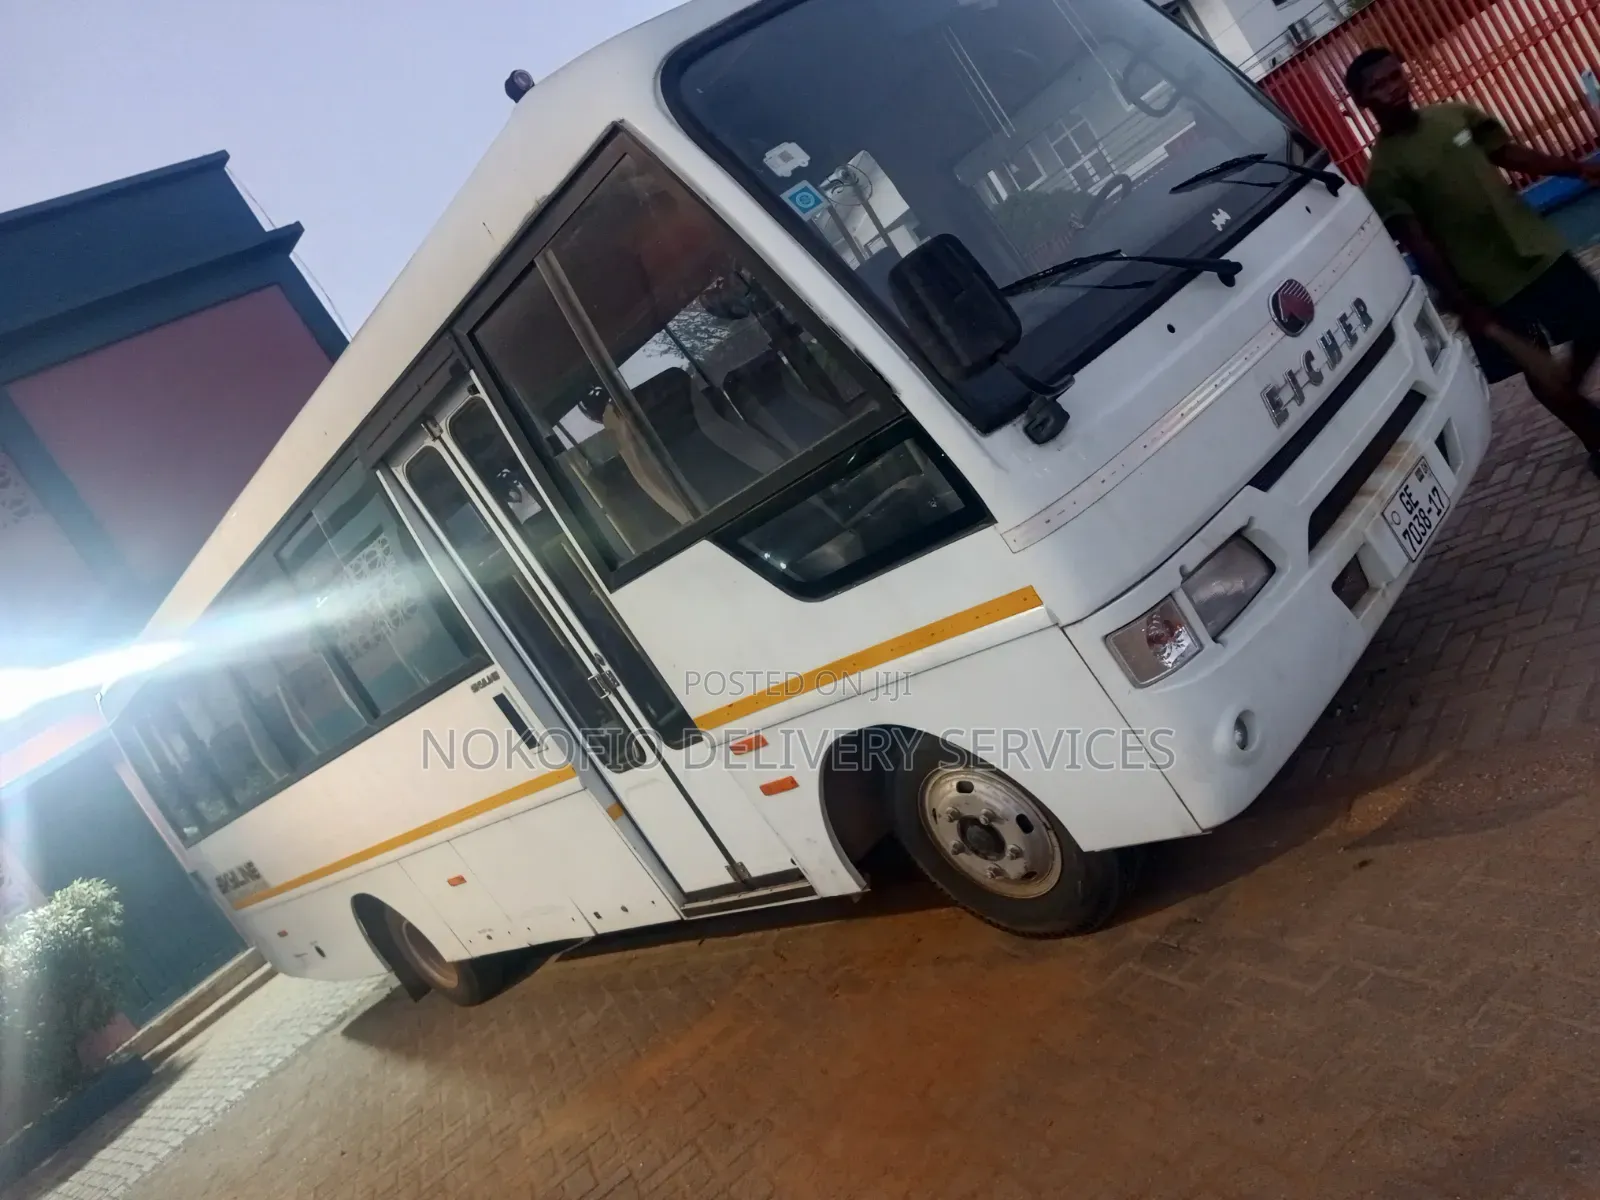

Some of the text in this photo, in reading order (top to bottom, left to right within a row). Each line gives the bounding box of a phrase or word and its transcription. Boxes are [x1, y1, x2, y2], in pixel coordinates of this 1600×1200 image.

[1260, 297, 1373, 428] EICHER
[1399, 484, 1419, 515] GE
[1402, 486, 1445, 553] 7038-17
